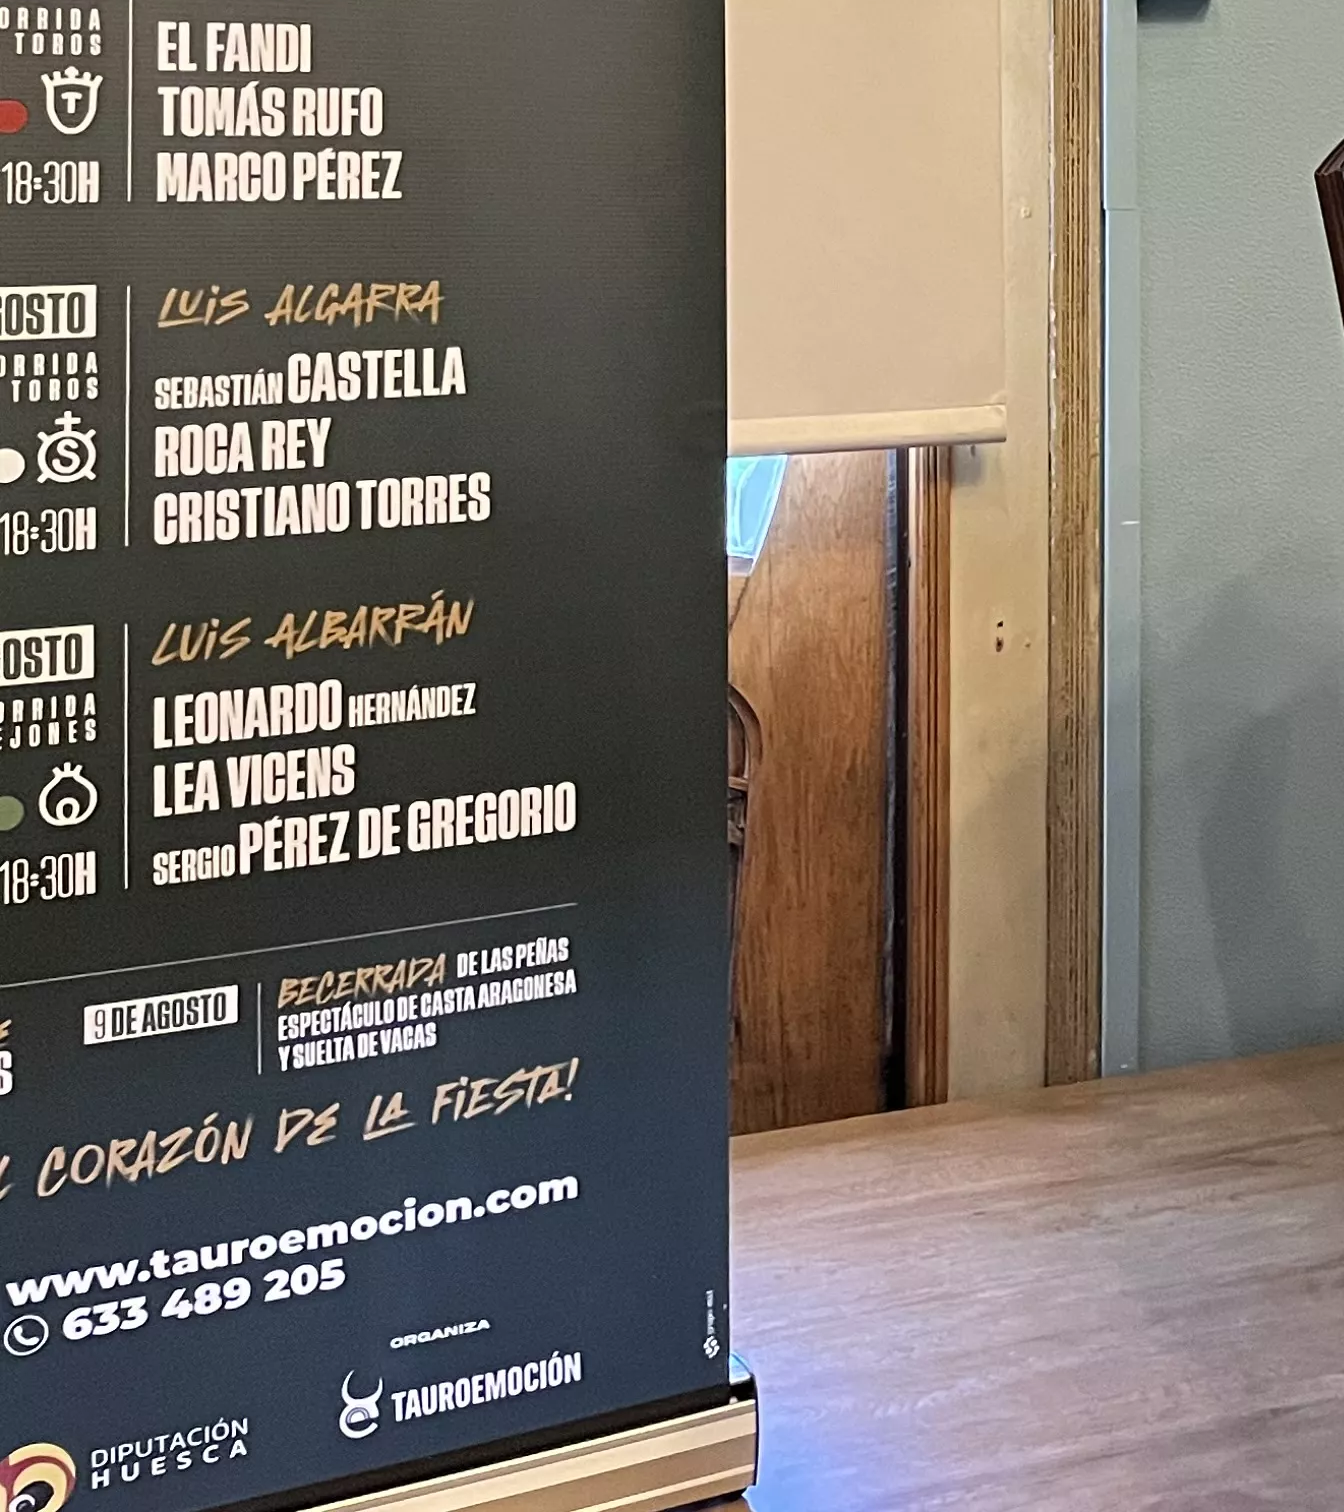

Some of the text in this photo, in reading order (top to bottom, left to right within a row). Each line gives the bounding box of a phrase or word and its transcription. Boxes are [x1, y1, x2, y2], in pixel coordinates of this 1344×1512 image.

[14, 32, 102, 56] TOROS
[158, 21, 311, 73] EL FANDI
[158, 82, 384, 137] TOMÁS RUFO
[1, 160, 99, 205] 18:30H
[156, 148, 403, 203] MARCO PÉREZ
[0, 292, 85, 336] OSTO
[264, 280, 446, 328] ALGARRA
[11, 377, 98, 402] TOROS
[154, 346, 467, 410] SEBASTIÁN CASTELLA
[154, 417, 332, 478] ROCA REY
[0, 506, 96, 556] 18:30H
[153, 472, 492, 546] CRISTIANO TORRES
[264, 590, 475, 661] ALBARRÁN
[0, 633, 82, 680] OSTO
[0, 718, 97, 749] JONES
[153, 679, 477, 749] LEONARDO HERNÁNDEZ
[153, 743, 356, 817] LEA VICENS
[152, 780, 577, 886] SERGIO PÉREZ DE GREGORIO
[0, 850, 96, 905] 18:30H
[278, 937, 570, 1009] BECERRADA DE LAS PEÑAS
[94, 992, 226, 1039] 9 DE AGOSTO
[278, 969, 577, 1041] ESPECTÁCULO DE CASTA ARAGONESA
[278, 1022, 437, 1072] Y SUELTA DE VACAS
[37, 1113, 255, 1199] CORAZÓN
[274, 1102, 341, 1155] DE
[362, 1091, 415, 1140] LA
[5, 1173, 579, 1309] www.tauroemocion.com
[62, 1258, 346, 1343] 633 489 205
[389, 1318, 491, 1350] ORGANIZA
[391, 1351, 583, 1424] TAUROEMOCIÓN
[91, 1417, 249, 1470] DIPUTACIÓN
[91, 1439, 248, 1490] HUESCA
